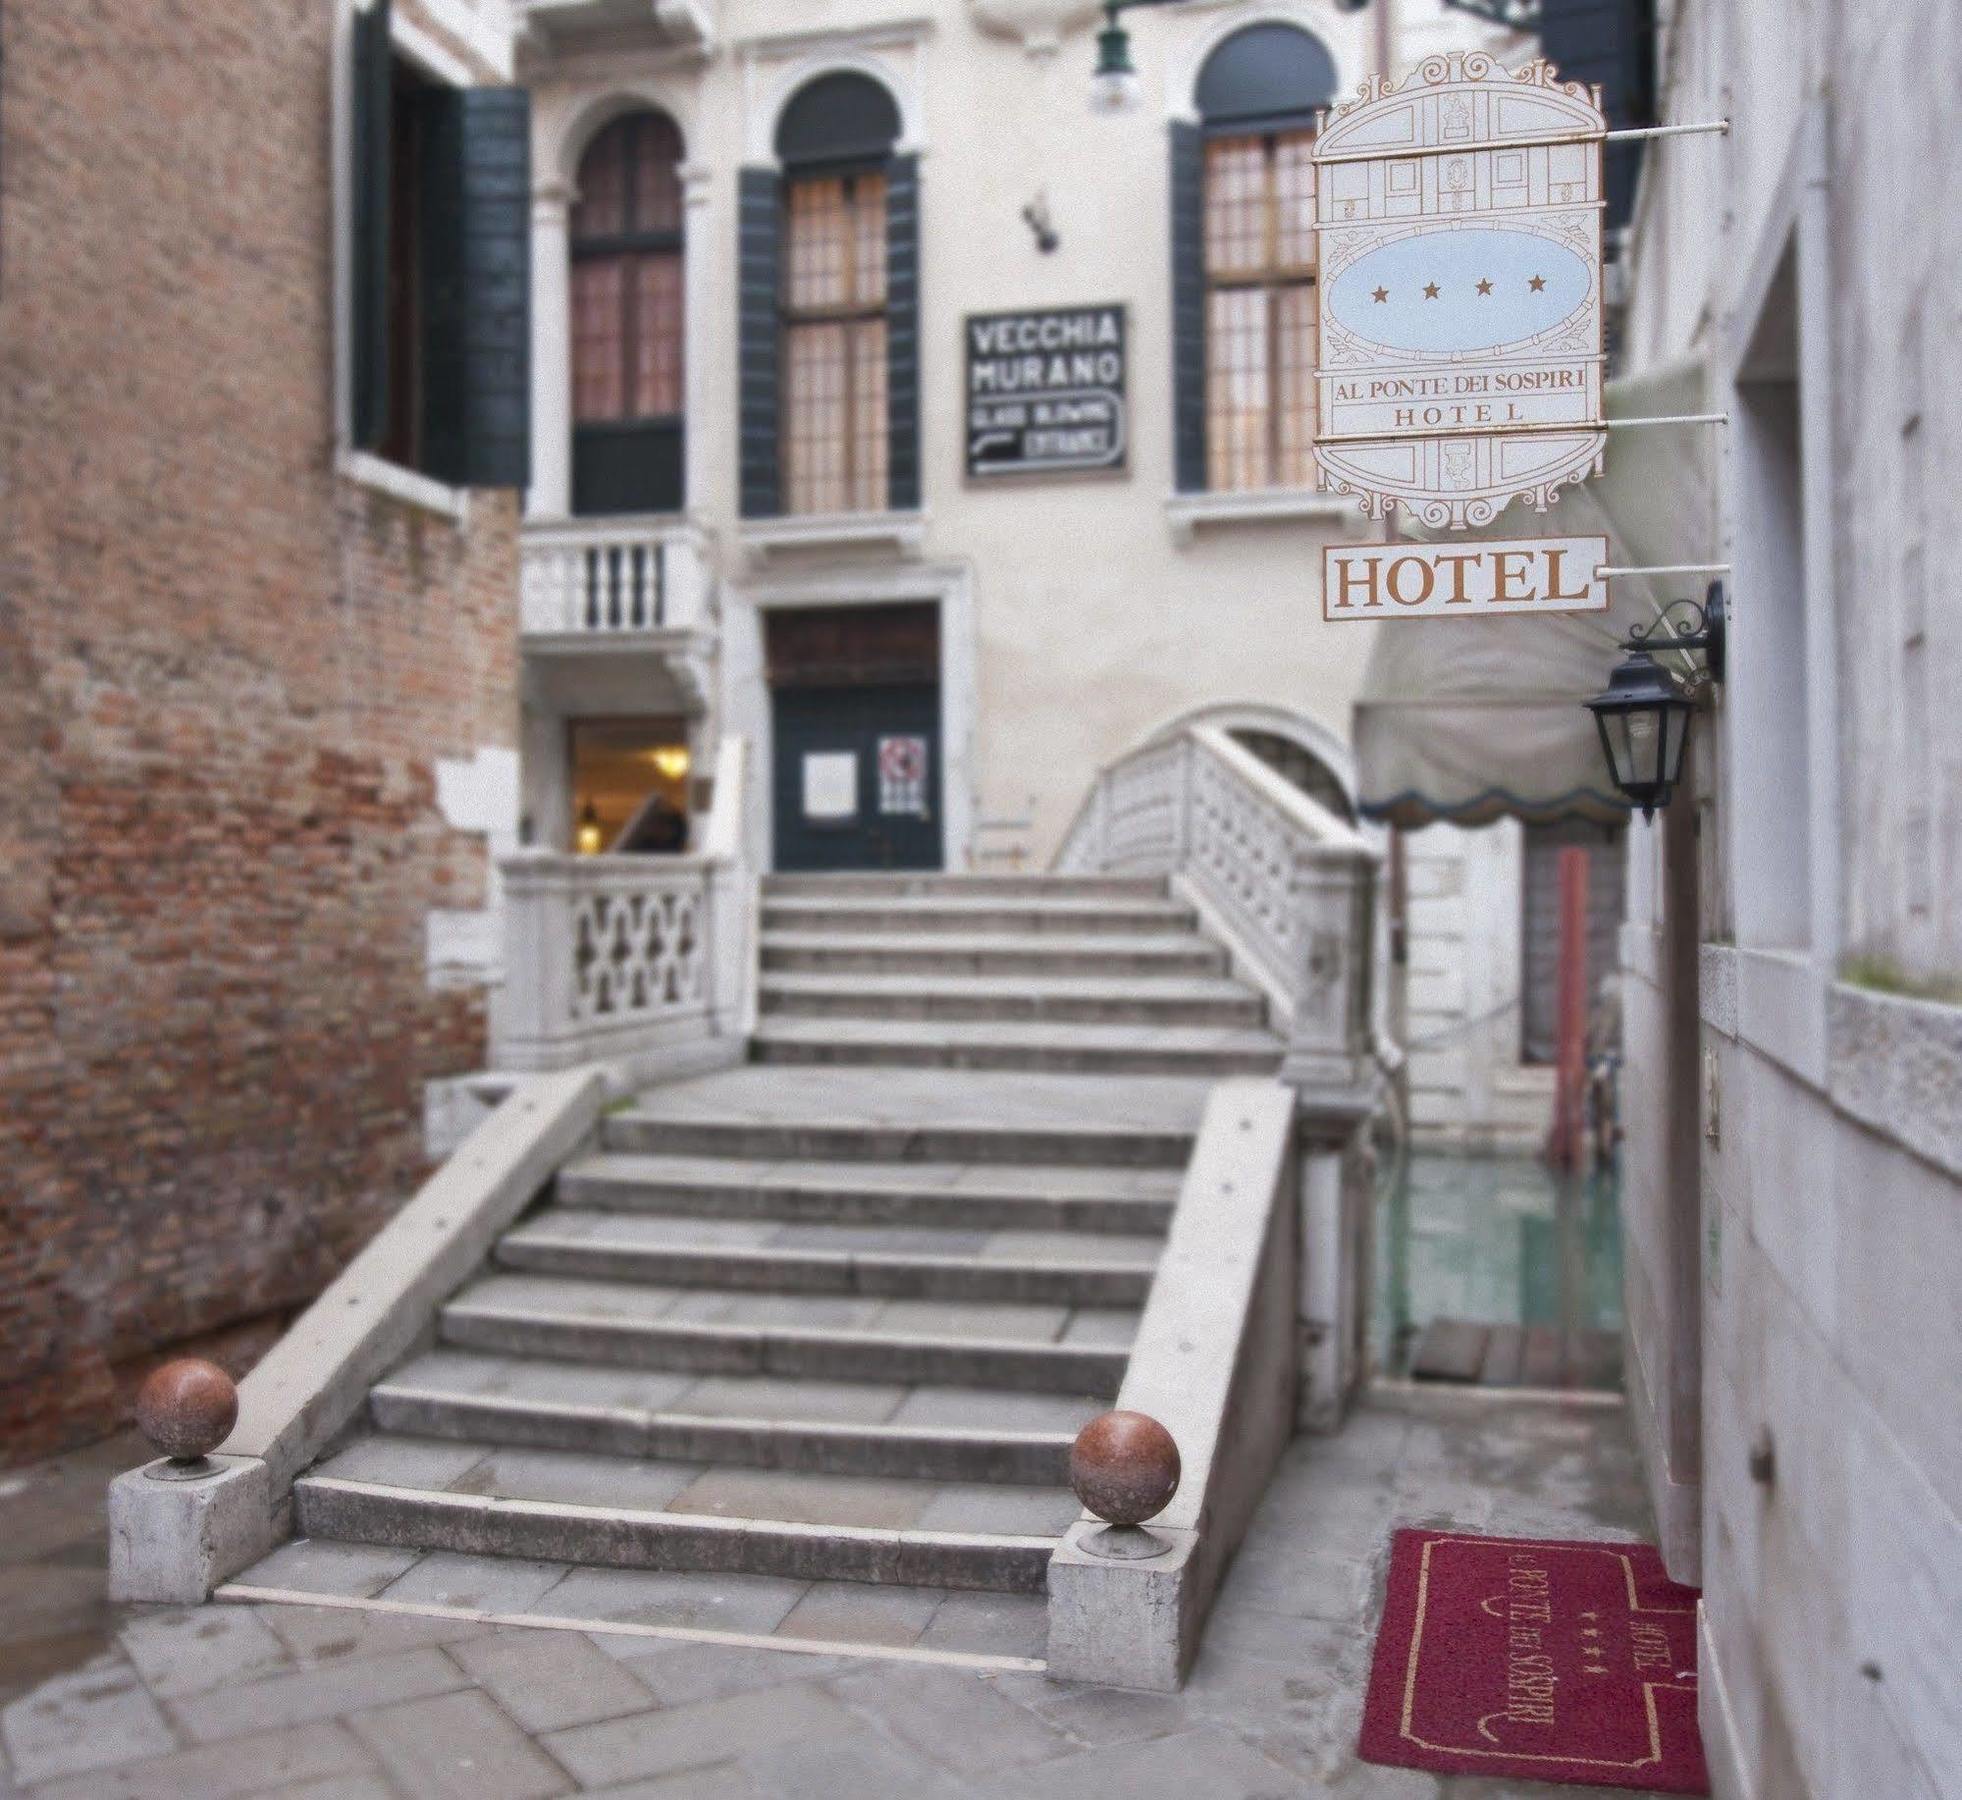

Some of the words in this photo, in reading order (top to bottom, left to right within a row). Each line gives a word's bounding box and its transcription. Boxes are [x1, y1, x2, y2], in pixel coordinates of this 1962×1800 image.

[972, 313, 1119, 354] VECCHIA
[972, 352, 1120, 392] MURANO
[1335, 383, 1364, 400] AL
[1369, 377, 1448, 398] PONTE
[1454, 375, 1489, 393] DEI
[1495, 369, 1585, 391] SOSPIRI
[1394, 403, 1523, 427] HOTEL
[1334, 549, 1590, 608] HOTEL
[1628, 1621, 1672, 1671] HOTEL
